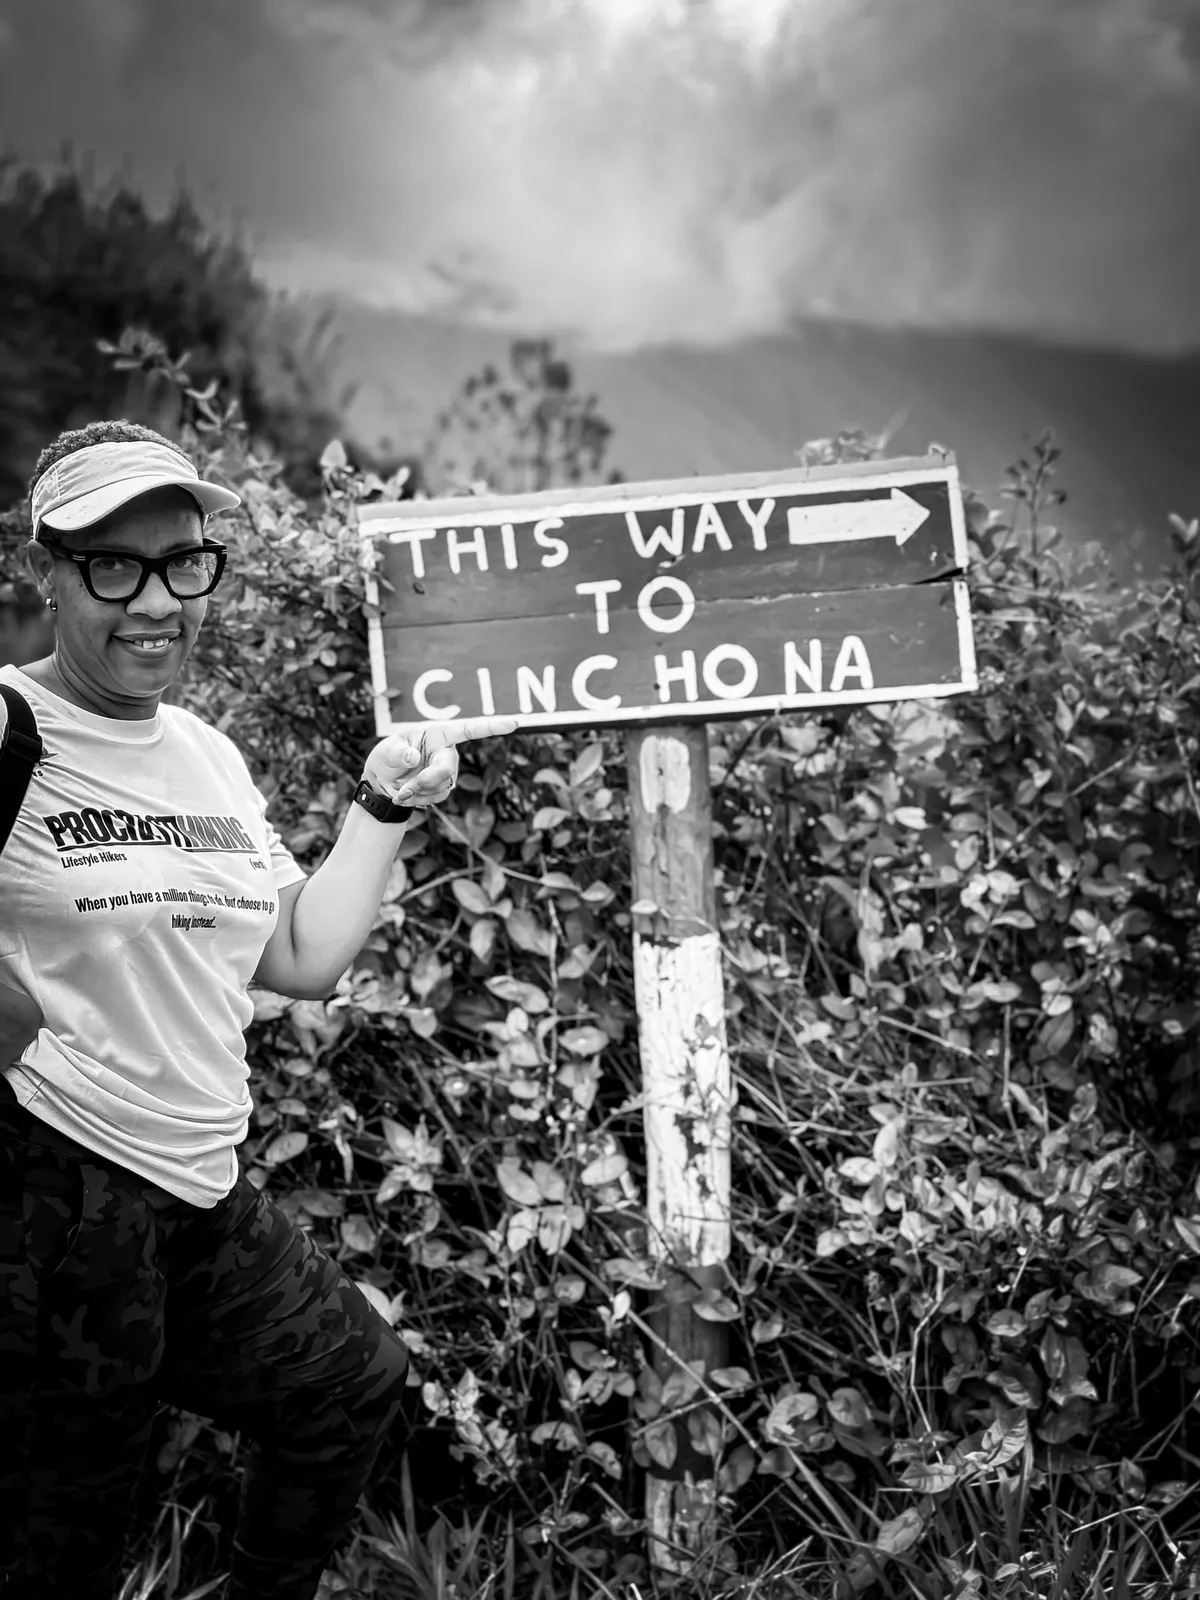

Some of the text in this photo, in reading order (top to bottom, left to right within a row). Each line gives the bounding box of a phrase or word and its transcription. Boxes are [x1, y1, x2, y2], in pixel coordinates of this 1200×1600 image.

[390, 498, 776, 578] THIS WAY
[575, 576, 695, 634] TO
[60, 851, 128, 869] Lifestyle Hikers
[74, 897, 108, 913] When
[108, 895, 129, 910] you
[130, 891, 154, 906] have
[155, 892, 163, 902] a
[162, 888, 188, 902] million
[188, 889, 209, 906] things
[225, 895, 236, 908] but
[237, 896, 261, 911] choose
[262, 900, 269, 911] to
[171, 914, 191, 931] hiking
